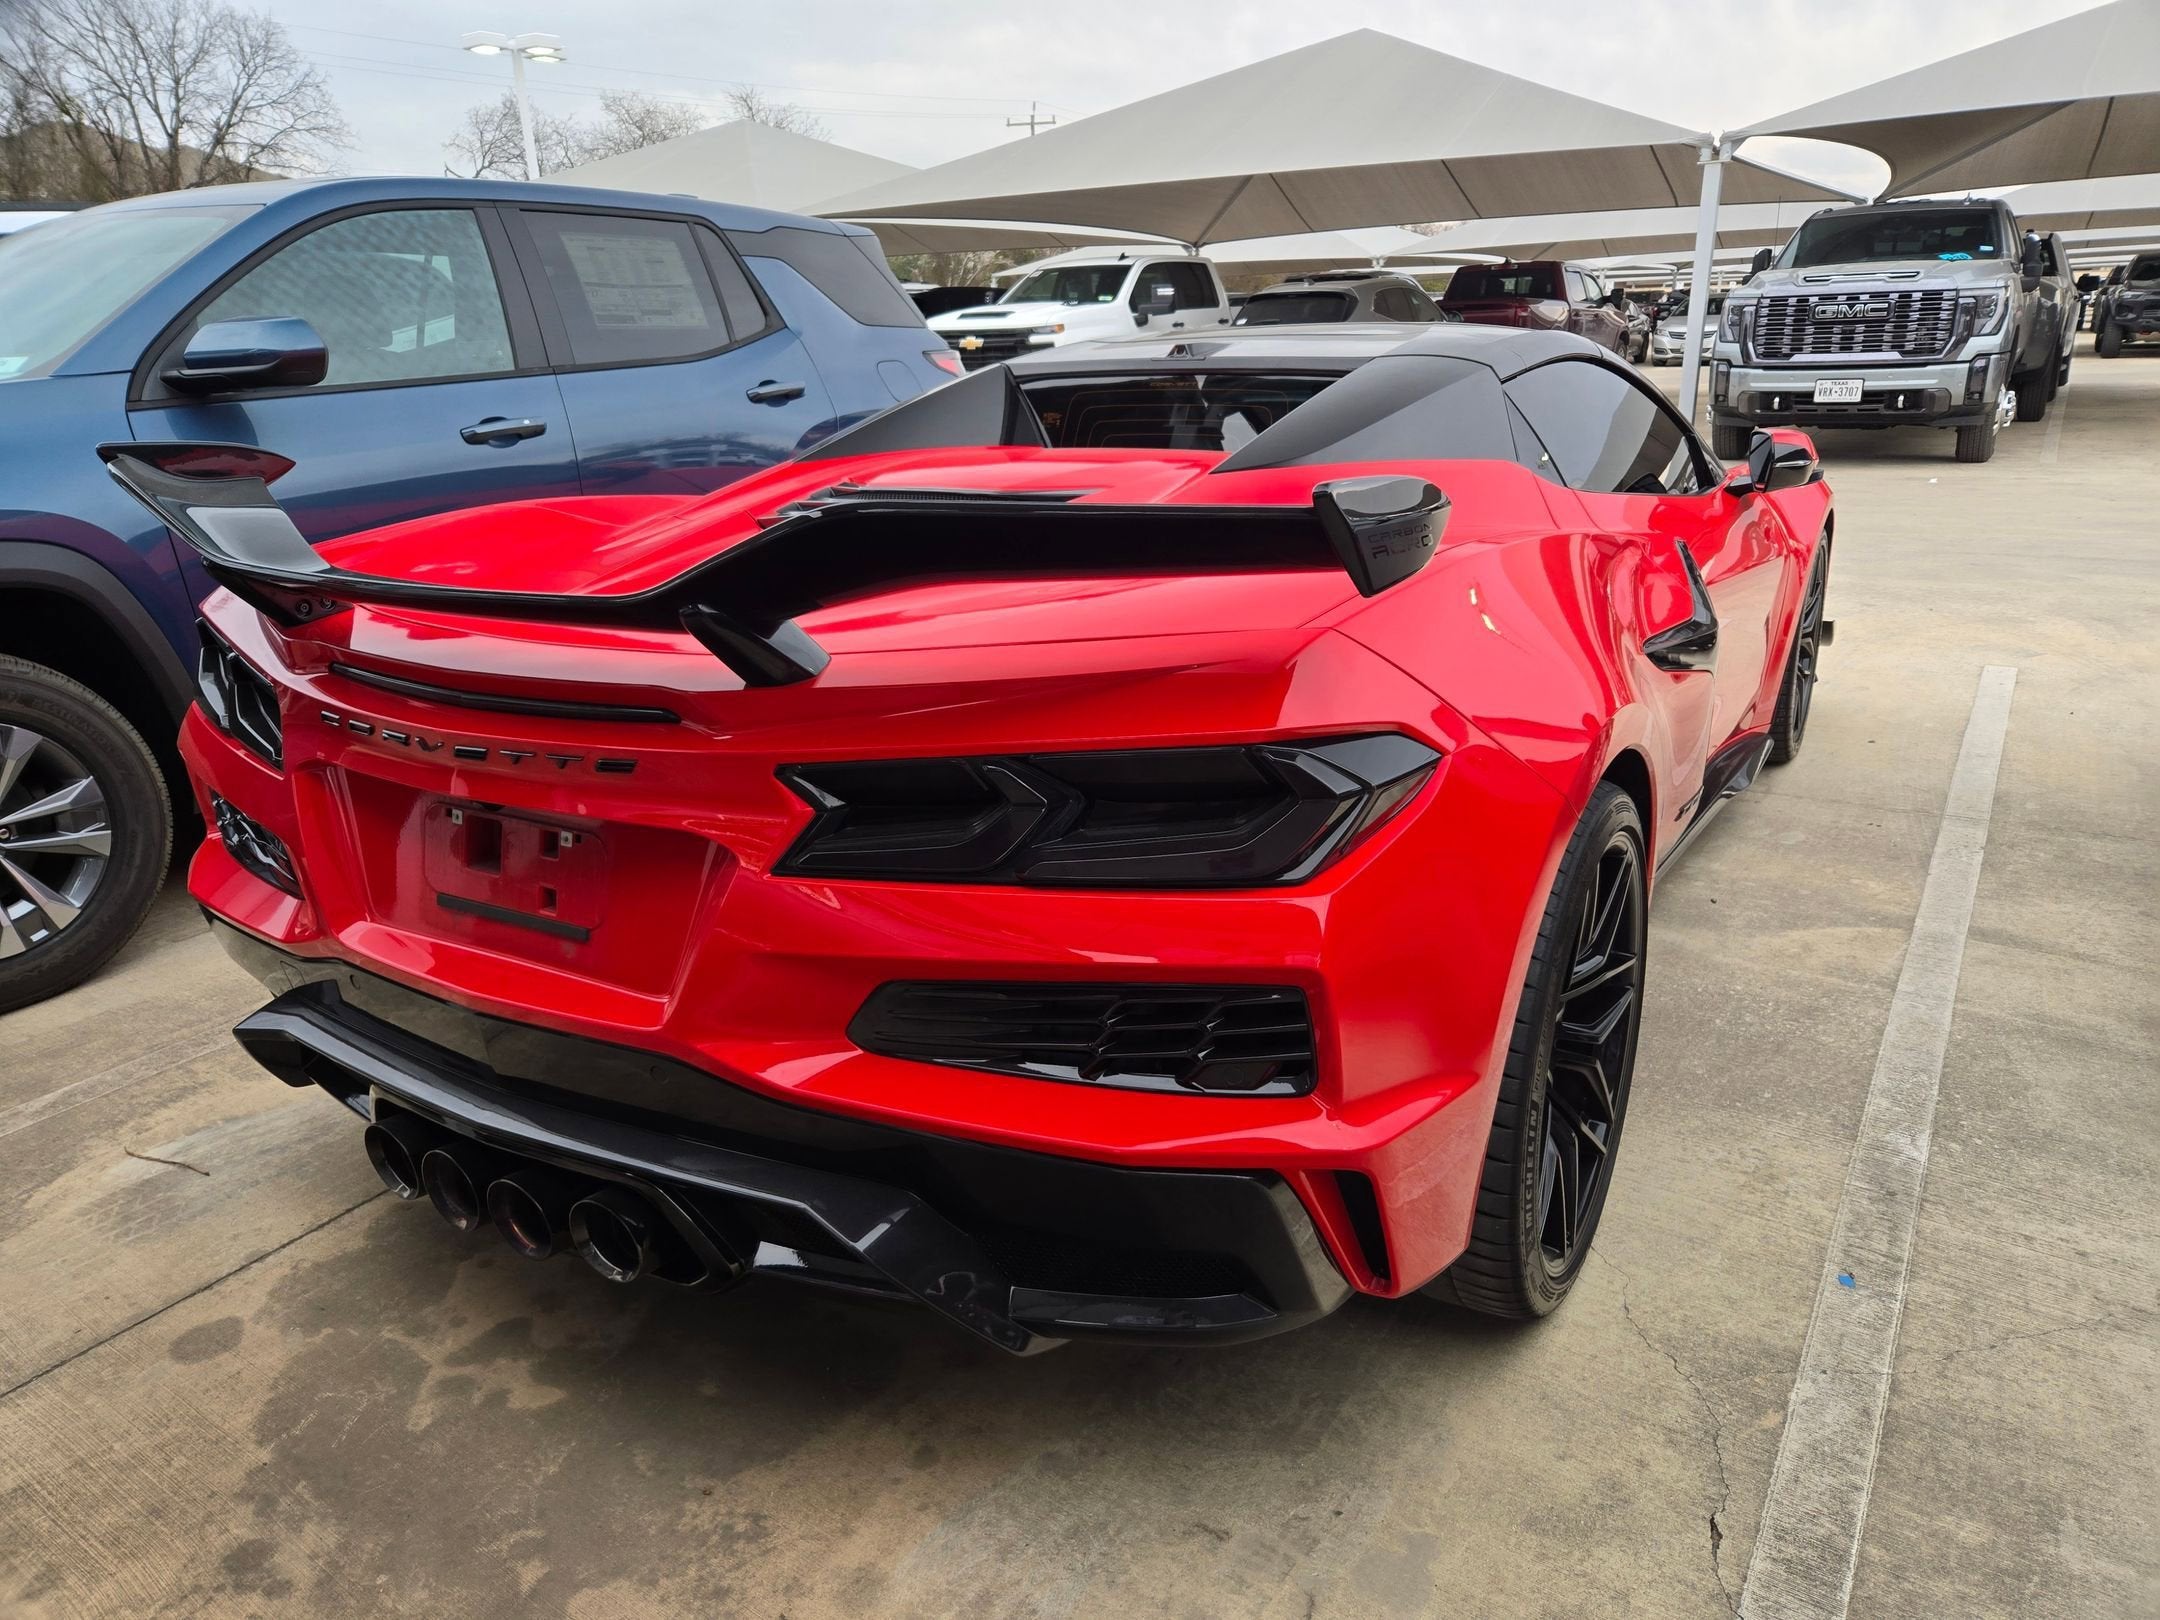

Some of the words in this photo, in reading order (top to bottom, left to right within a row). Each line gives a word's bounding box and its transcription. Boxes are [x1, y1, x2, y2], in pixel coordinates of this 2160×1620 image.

[1815, 303, 1889, 319] GMC
[1367, 523, 1433, 544] CARBON
[320, 710, 638, 774] CORVETTE
[1524, 1109, 1538, 1227] MICHELIN
[1535, 1043, 1547, 1091] PILOT
